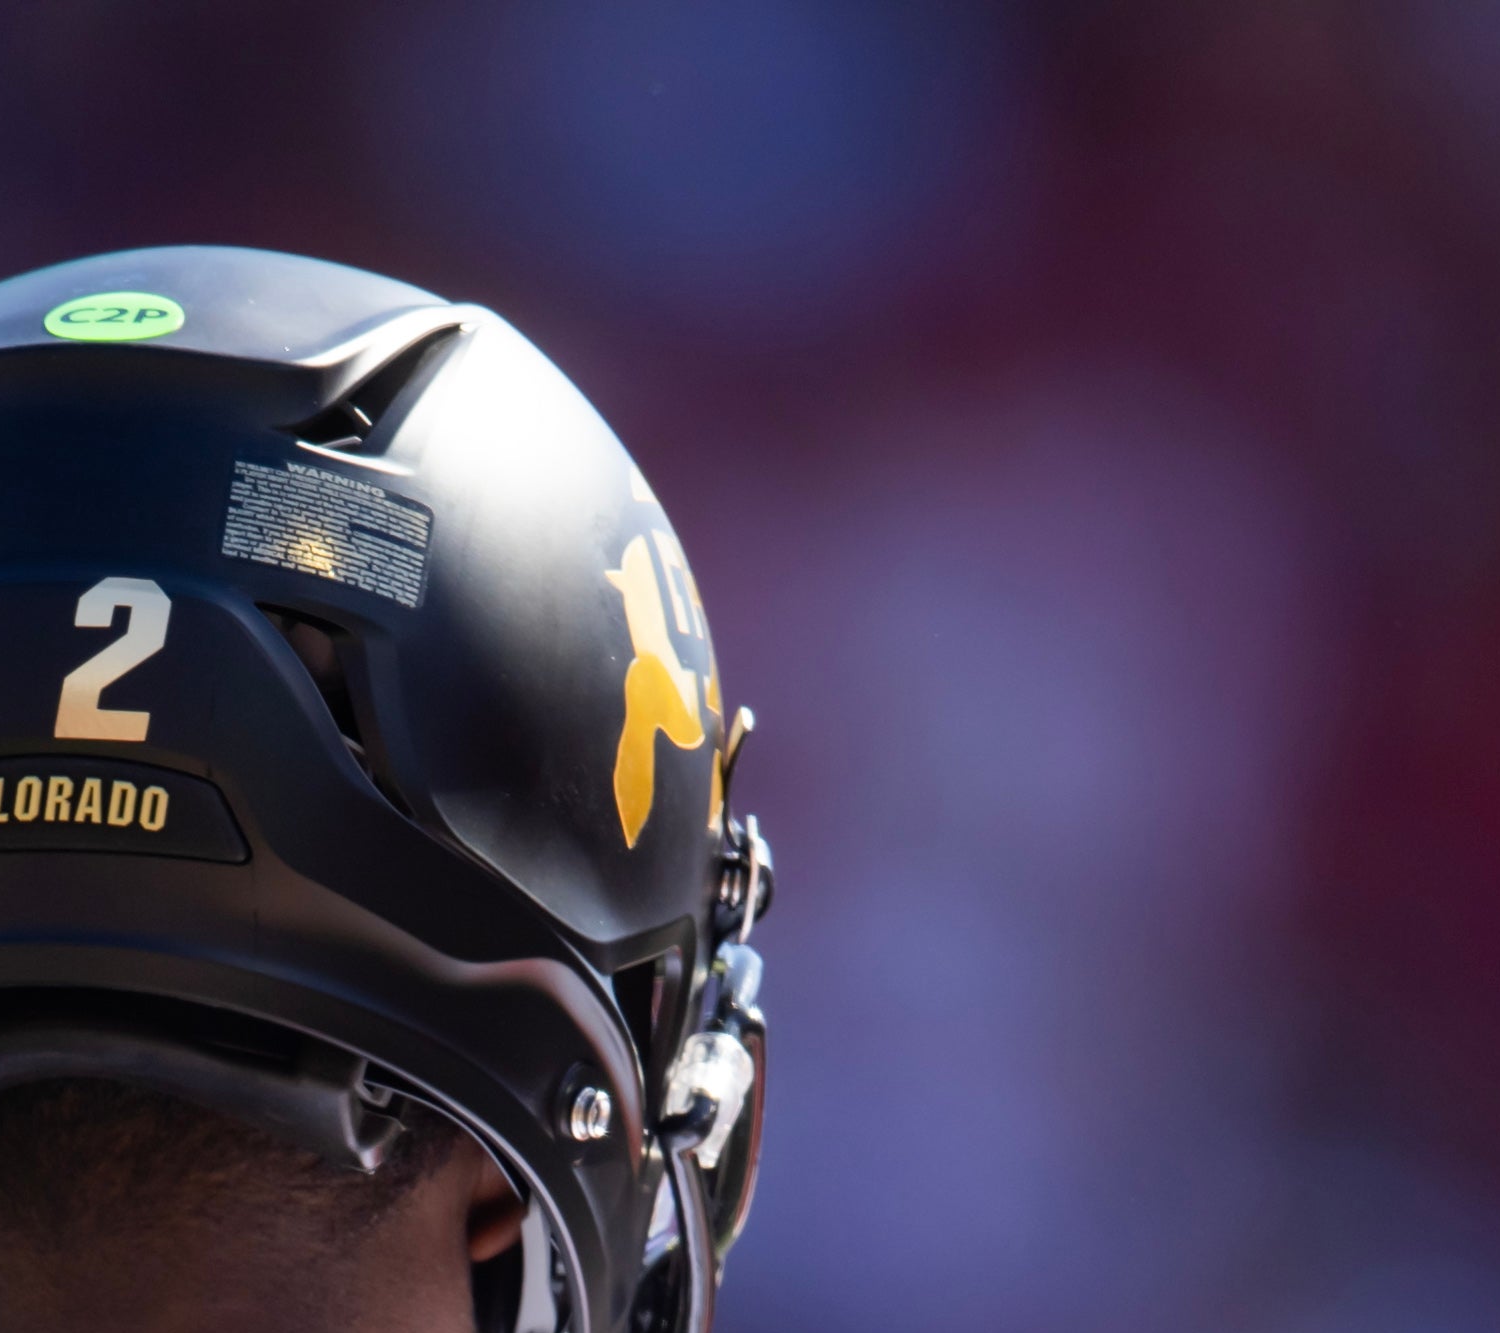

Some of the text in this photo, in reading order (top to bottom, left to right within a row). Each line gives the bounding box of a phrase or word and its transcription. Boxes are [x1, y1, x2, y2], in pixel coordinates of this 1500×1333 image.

[59, 307, 169, 324] C2P
[286, 461, 387, 498] WARNING
[53, 576, 173, 742] 2
